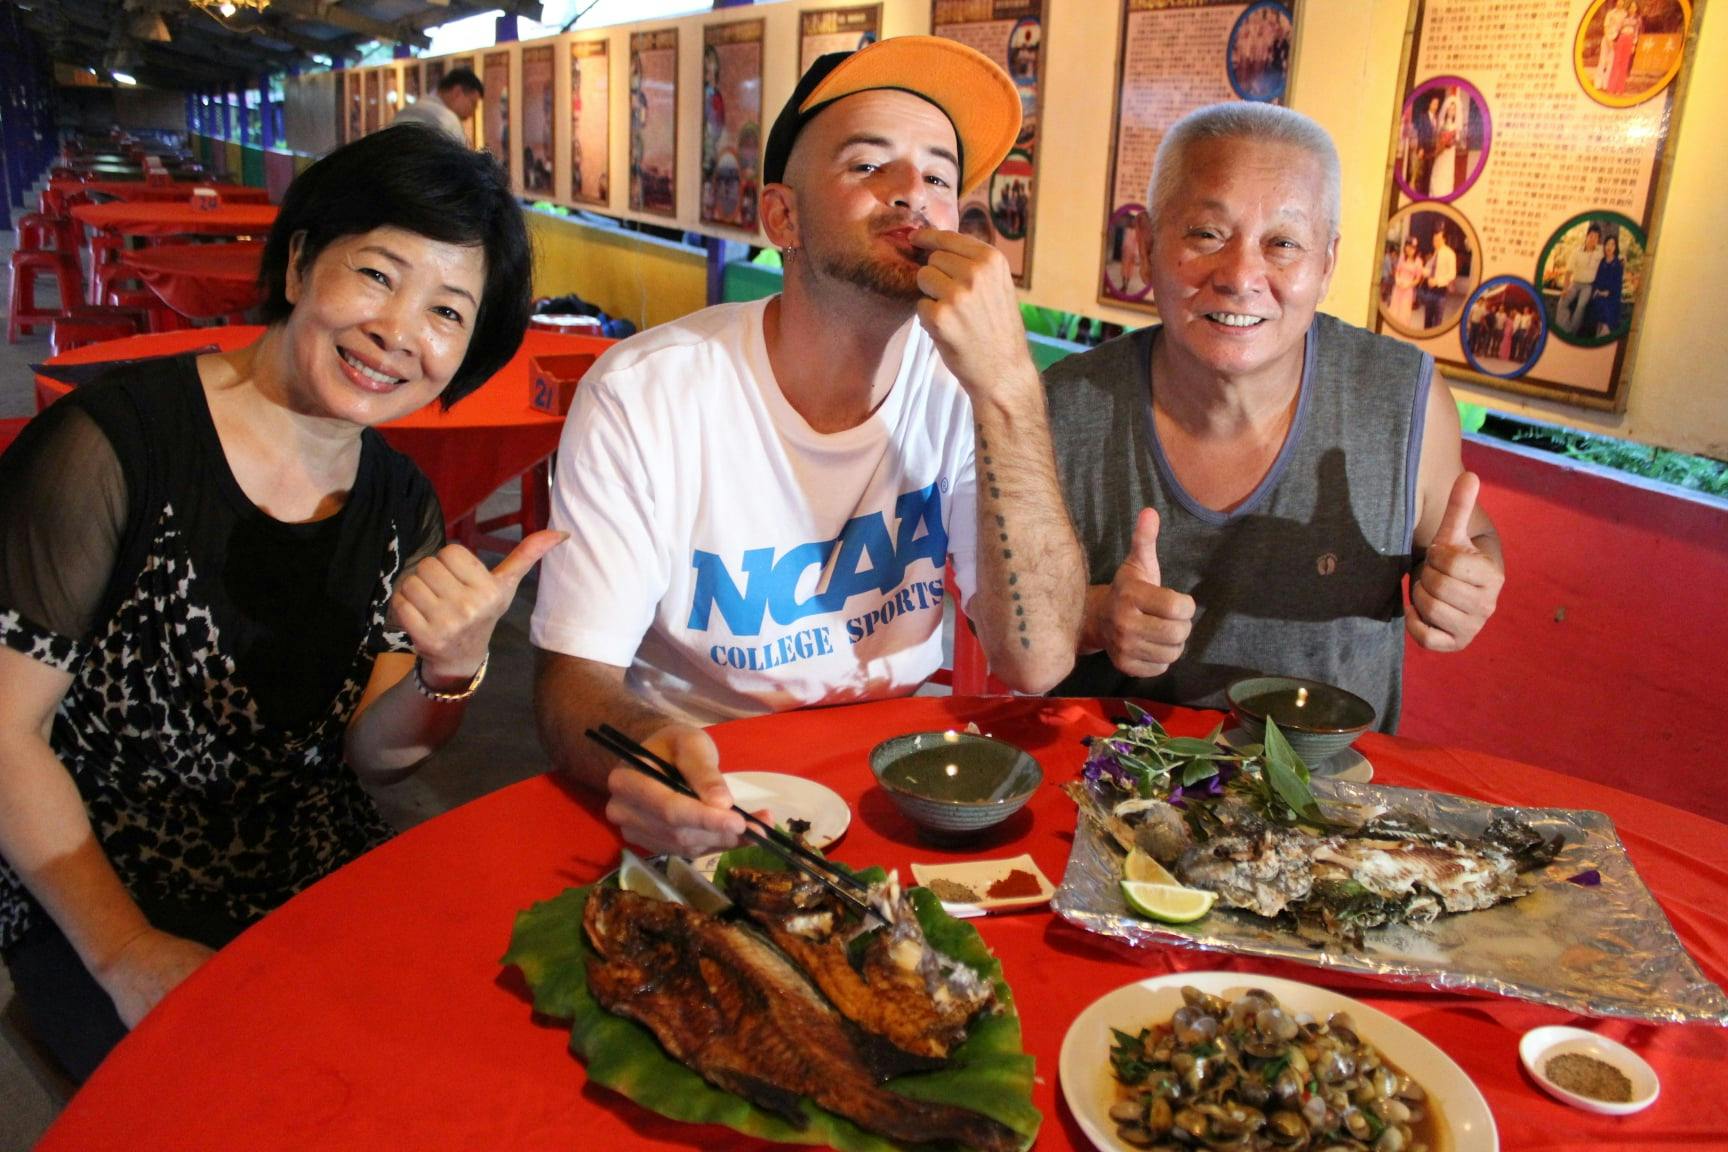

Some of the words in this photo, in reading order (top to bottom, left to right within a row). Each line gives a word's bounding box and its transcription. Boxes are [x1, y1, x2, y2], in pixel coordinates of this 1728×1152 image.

[687, 481, 949, 636] NCAA
[710, 626, 833, 671] COLLEGE
[846, 578, 944, 644] SPORTS
